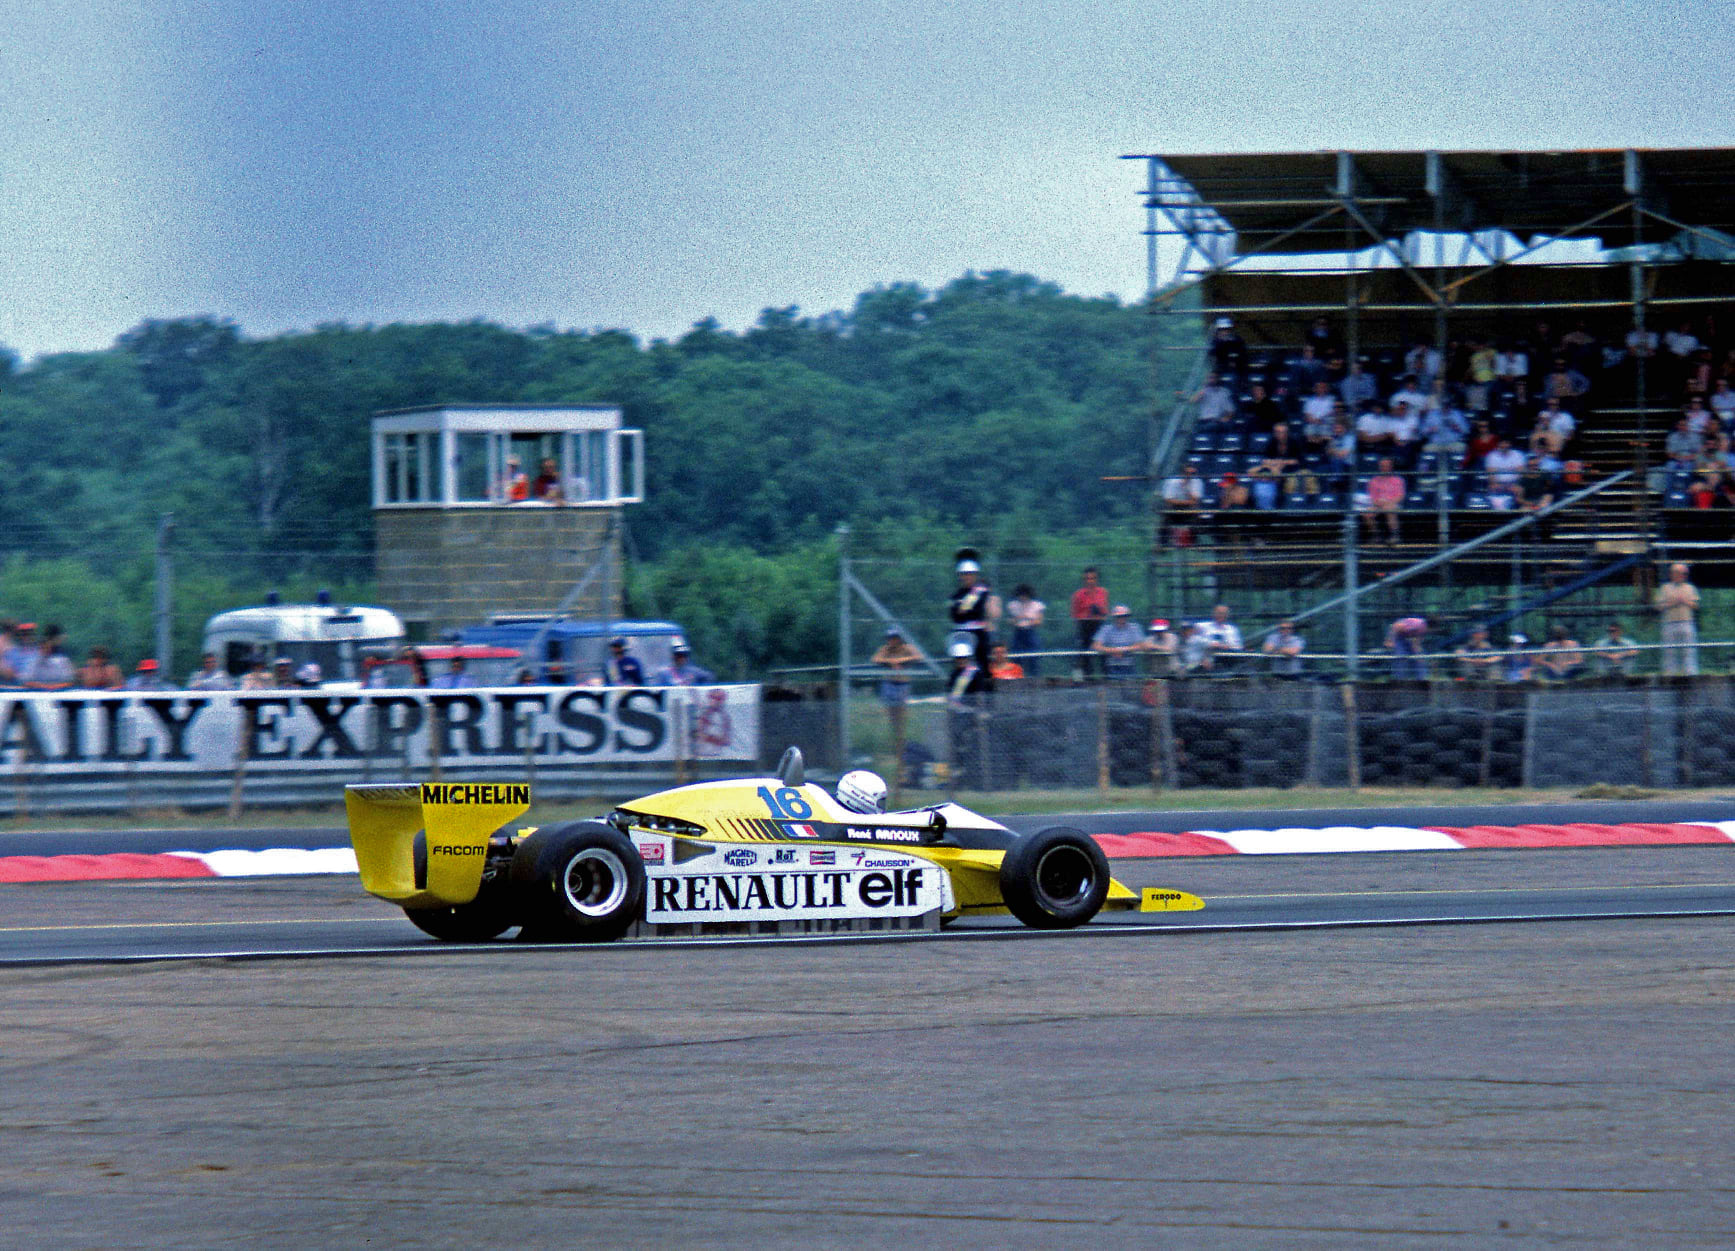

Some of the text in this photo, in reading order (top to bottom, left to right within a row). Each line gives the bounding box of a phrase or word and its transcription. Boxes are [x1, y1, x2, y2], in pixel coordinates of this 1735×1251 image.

[238, 690, 667, 760] EXPRESS
[422, 785, 529, 804] MICHELIN
[757, 786, 813, 820] 16
[432, 845, 484, 856] FACOM
[864, 859, 910, 868] CHAUSSON
[651, 869, 923, 912] RENAULT elf
[1151, 893, 1181, 901] FERODO
